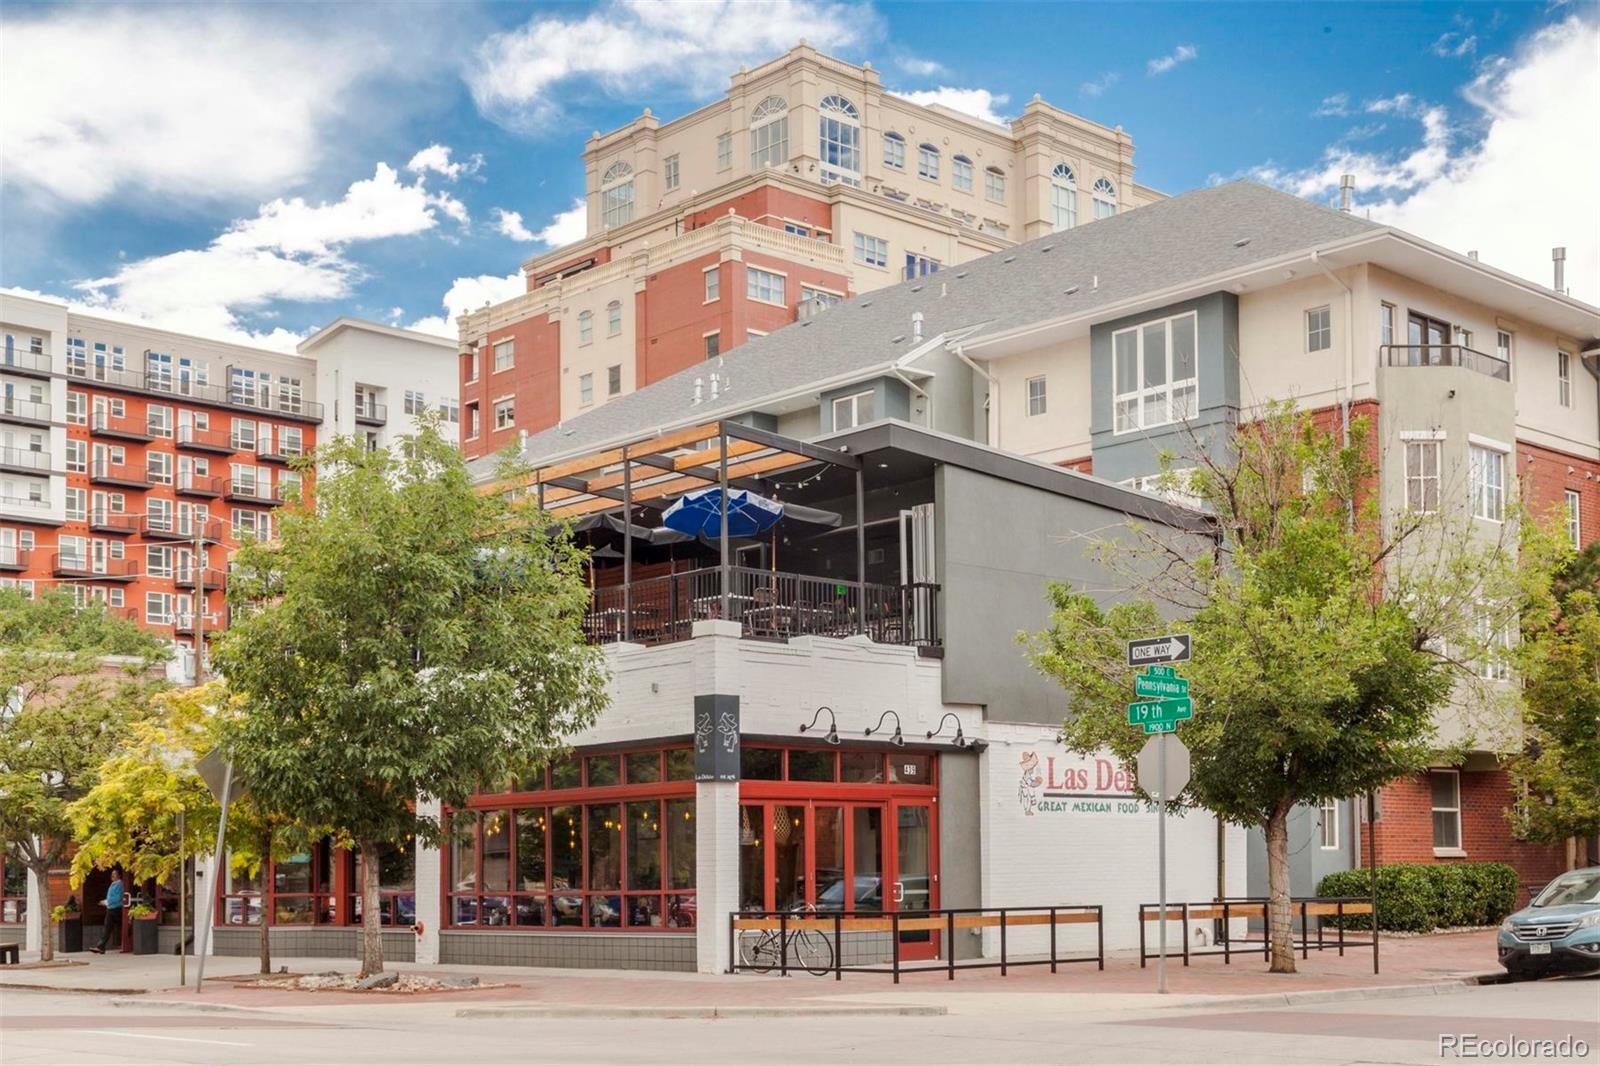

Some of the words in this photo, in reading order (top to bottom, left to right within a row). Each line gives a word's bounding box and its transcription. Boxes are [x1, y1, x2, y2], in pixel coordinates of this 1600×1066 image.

[1134, 646, 1151, 658] ONE
[1153, 644, 1171, 656] WAY
[1137, 677, 1180, 694] Pennsylvania
[1148, 723, 1164, 731] 1900
[1165, 722, 1171, 730] N
[1046, 757, 1088, 791] Las
[1095, 759, 1135, 791] Del
[1037, 801, 1067, 812] GREAT
[1072, 802, 1112, 813] MEXICAN
[1117, 803, 1140, 814] FOOD
